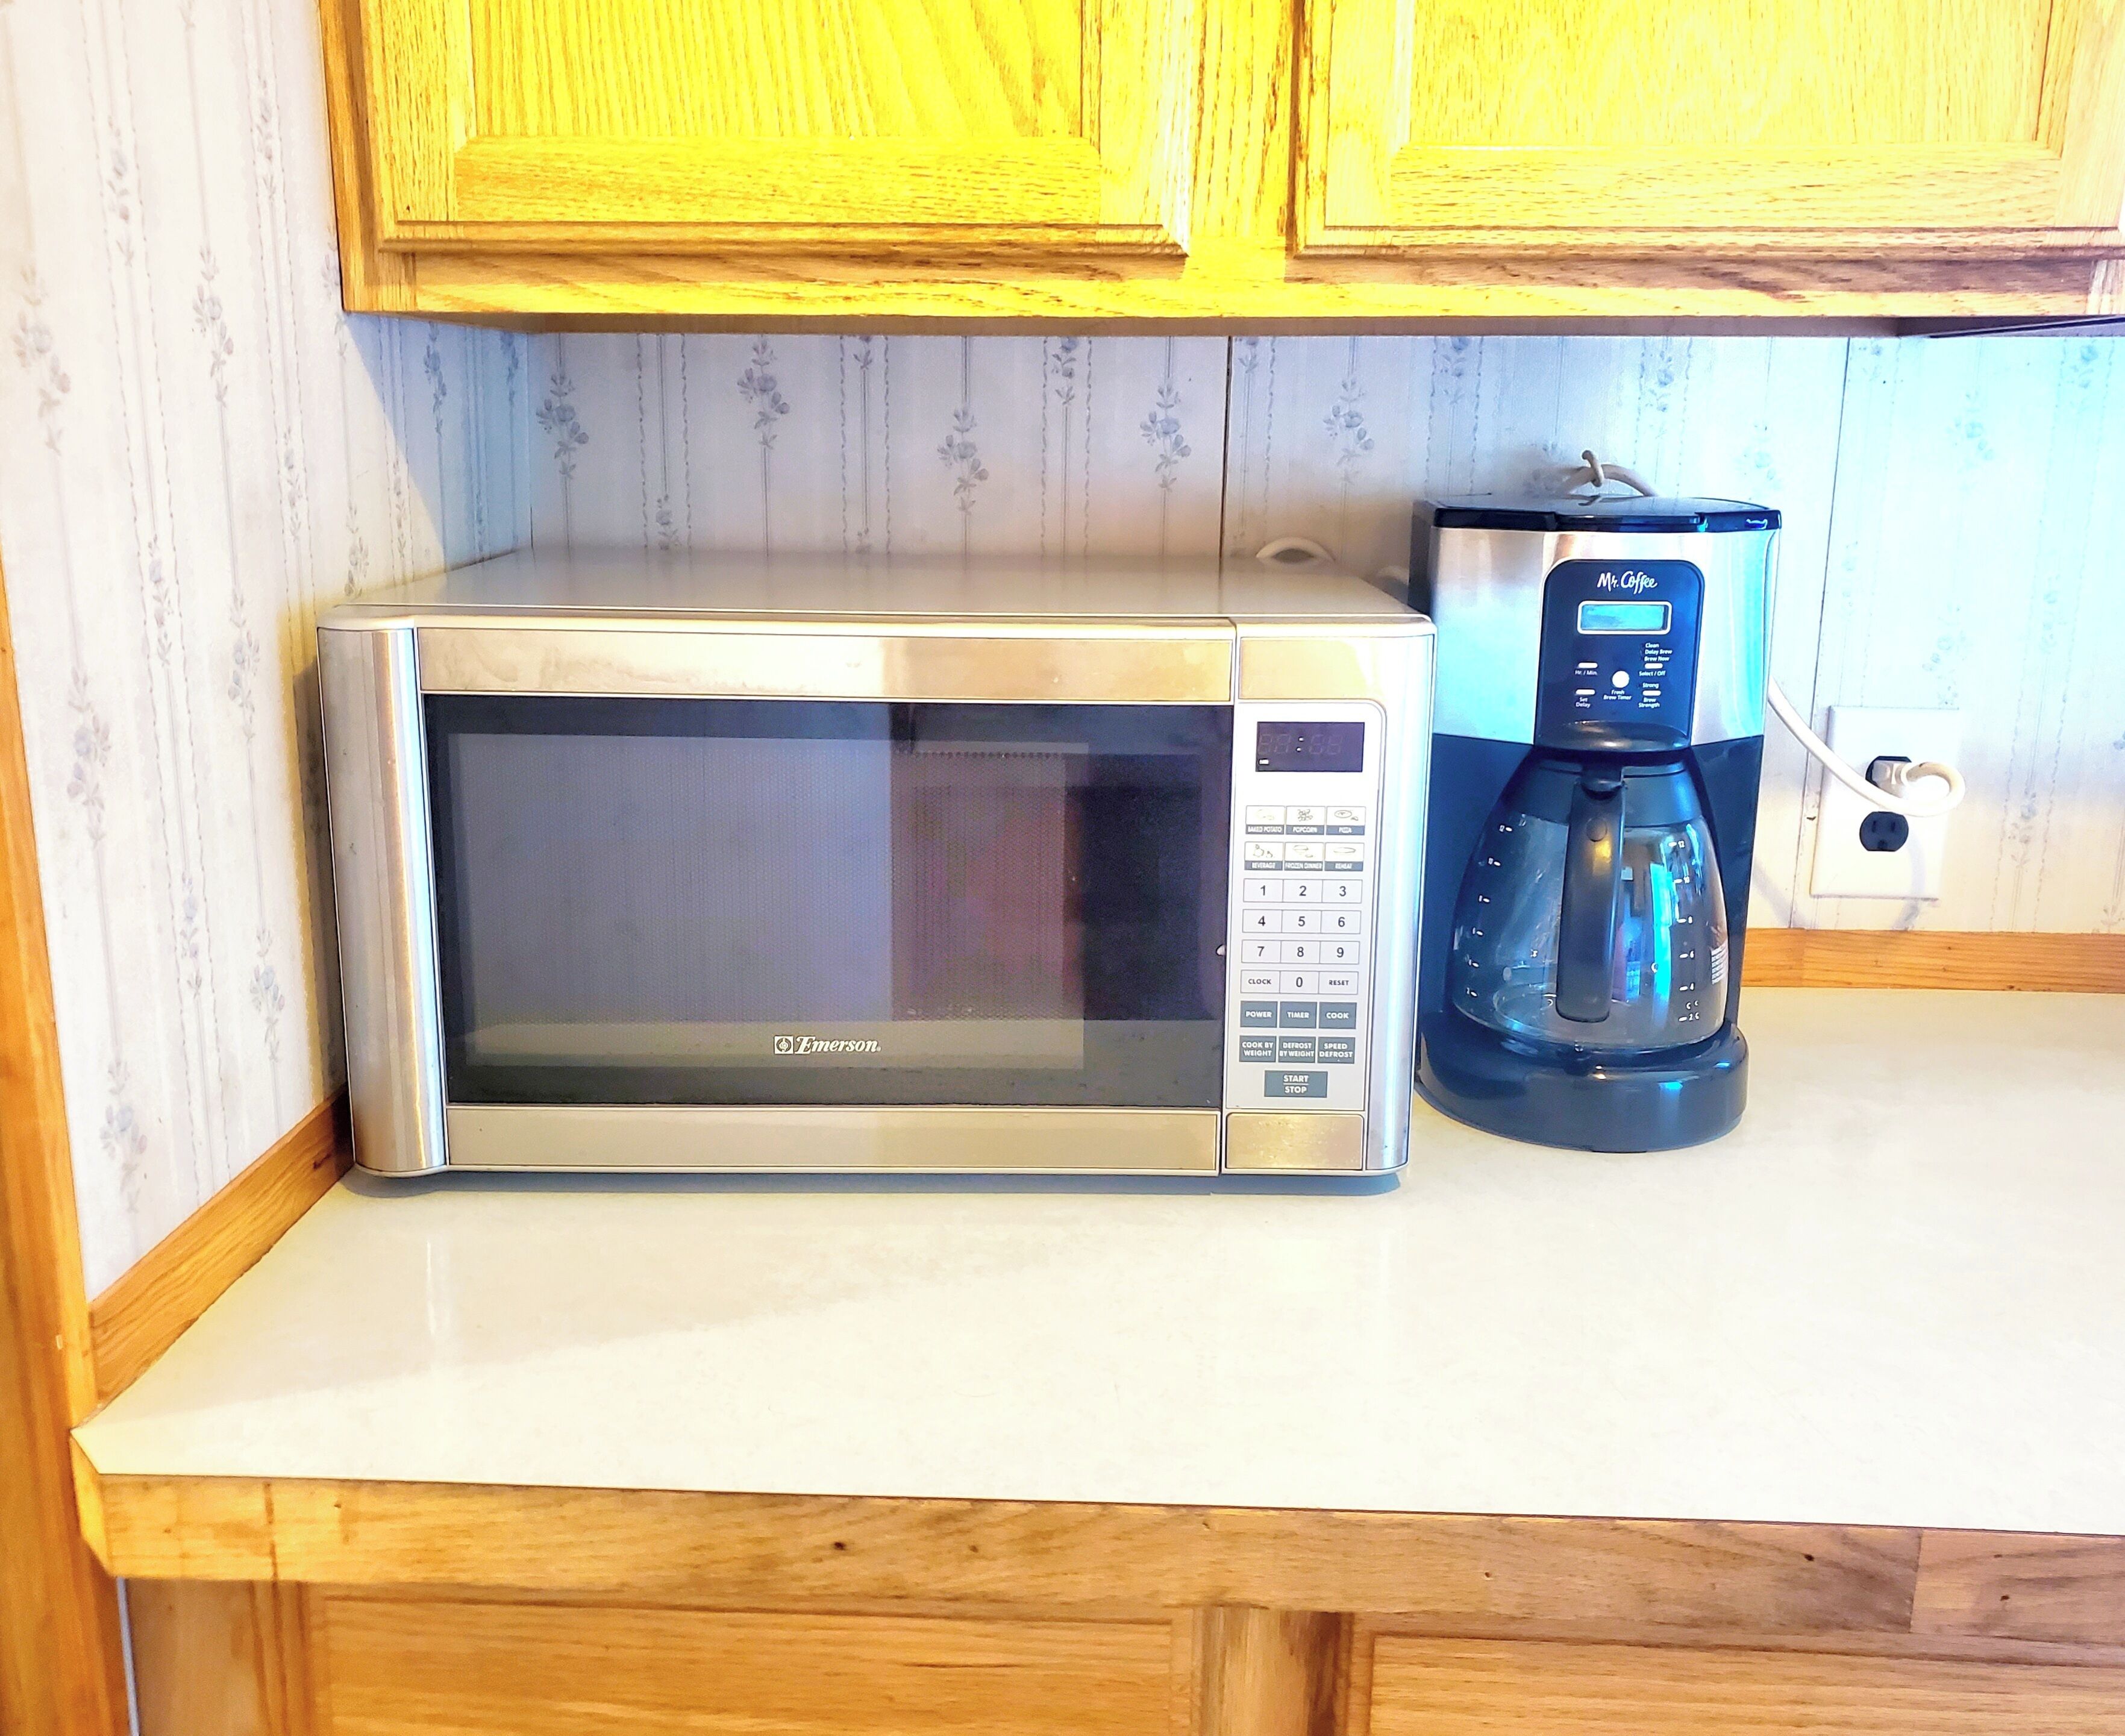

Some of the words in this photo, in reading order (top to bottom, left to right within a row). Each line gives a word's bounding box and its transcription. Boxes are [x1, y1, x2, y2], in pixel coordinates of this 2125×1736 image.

[1597, 572, 1619, 592] Mr.
[1620, 571, 1657, 594] Coffee
[1260, 885, 1266, 896] 1
[1299, 886, 1307, 896] 2
[1339, 886, 1347, 897] 3
[1258, 916, 1266, 926] 4
[1298, 916, 1306, 927] 5
[1338, 917, 1345, 927] 6
[1257, 946, 1265, 956] 7
[1297, 947, 1304, 957] 8
[1337, 947, 1344, 957] 9
[1296, 977, 1303, 987] 0
[795, 1036, 878, 1054] Emerson
